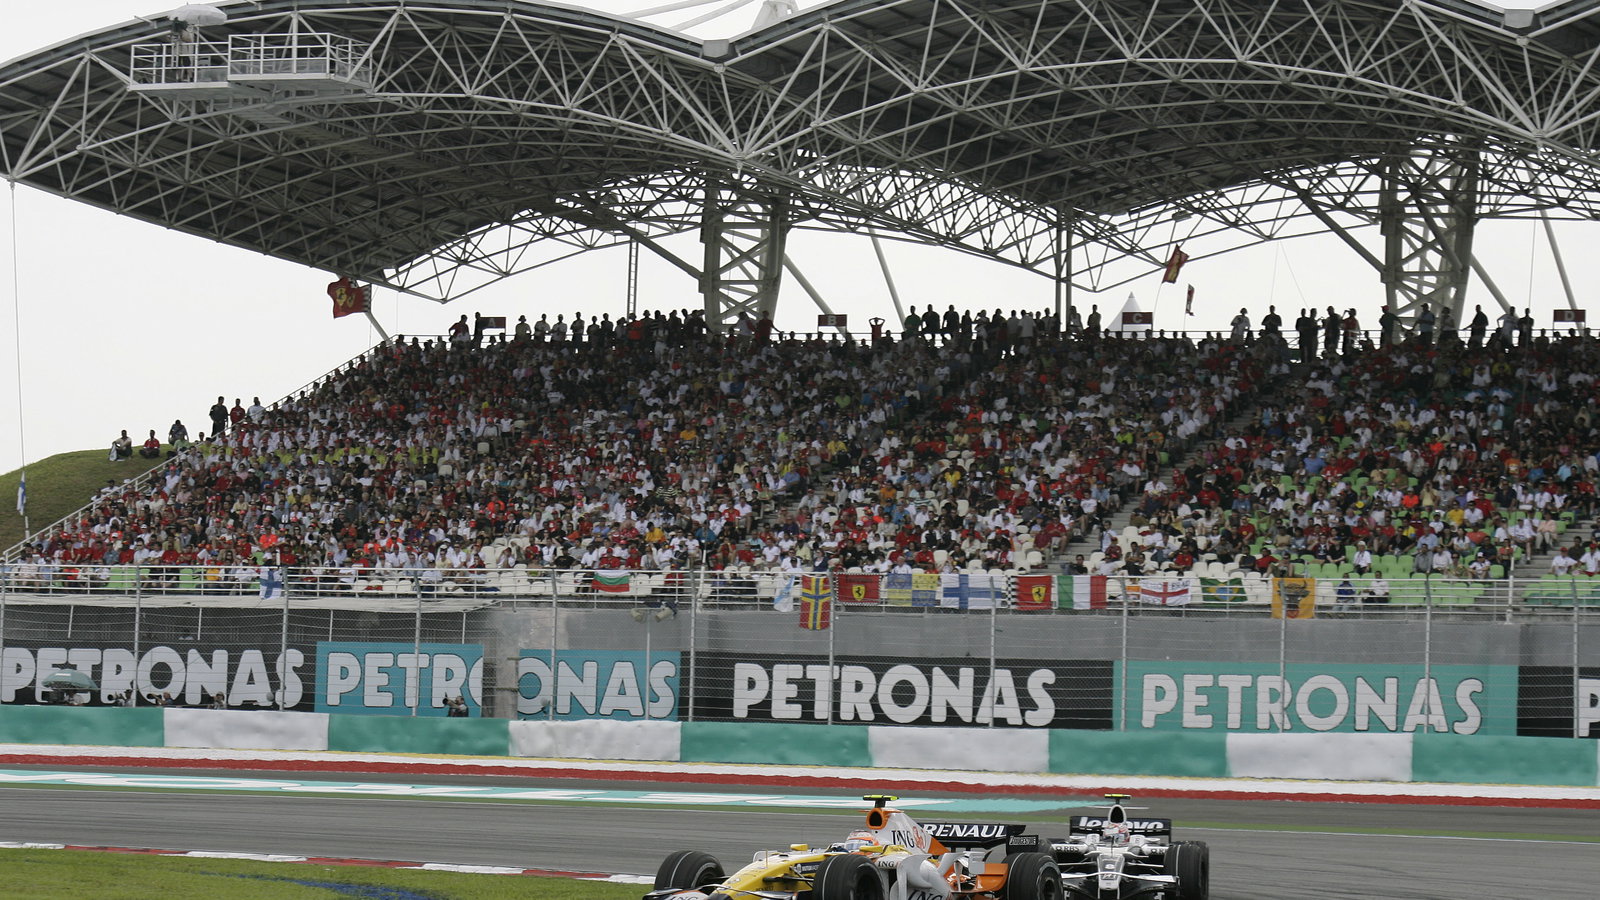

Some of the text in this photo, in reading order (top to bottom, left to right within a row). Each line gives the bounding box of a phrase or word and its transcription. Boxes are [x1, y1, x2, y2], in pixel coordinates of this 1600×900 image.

[488, 318, 496, 328] A
[828, 315, 837, 325] B
[1133, 313, 1143, 323] C
[0, 646, 304, 708] PETRONAS
[326, 652, 483, 708] PETR
[733, 663, 1056, 727] PETRONAS
[1140, 673, 1484, 735] PETRONAS
[891, 830, 915, 848] ING
[923, 824, 1007, 838] RENAUL
